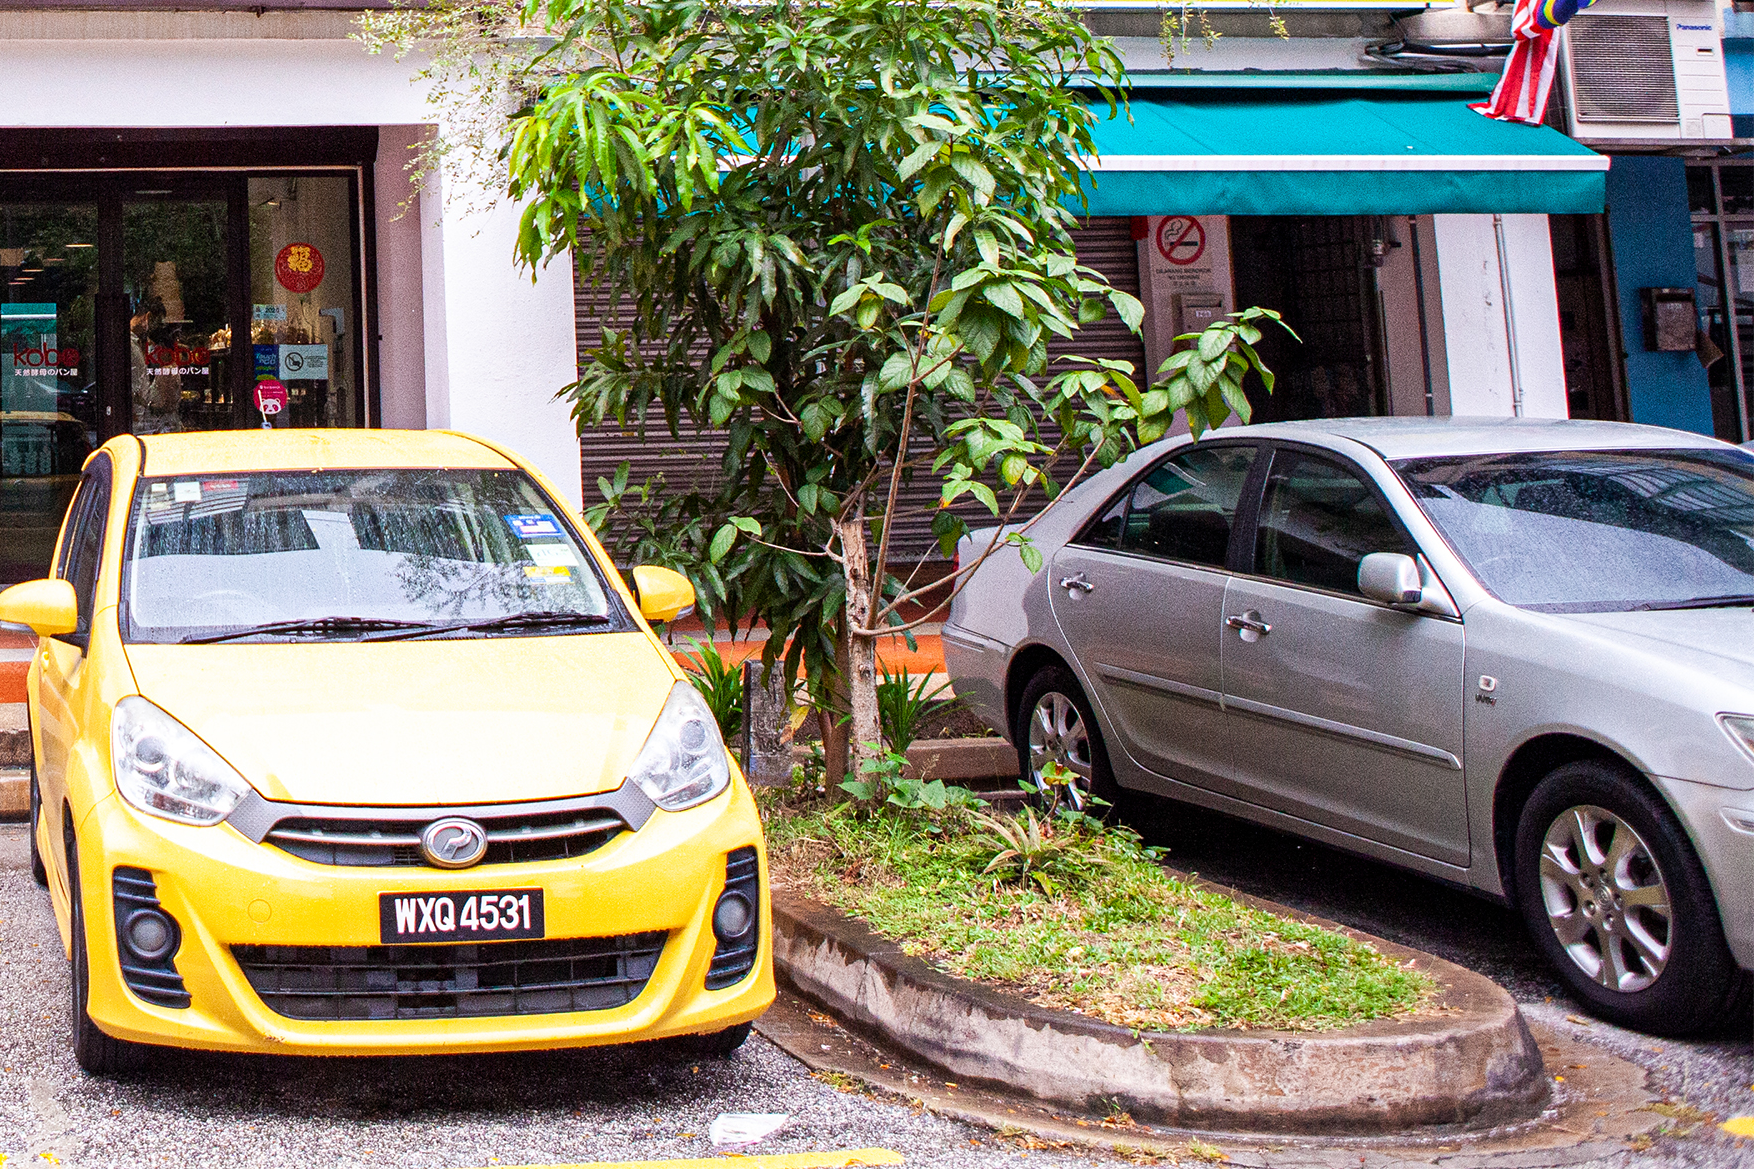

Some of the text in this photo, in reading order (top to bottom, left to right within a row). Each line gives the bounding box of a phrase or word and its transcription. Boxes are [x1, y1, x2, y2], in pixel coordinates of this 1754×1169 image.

[1676, 23, 1713, 31] Panasonic
[12, 342, 80, 367] kobo
[145, 341, 211, 367] kobo
[14, 368, 78, 376] 天然酵母のパン屋
[394, 894, 532, 934] WXQ 4531
